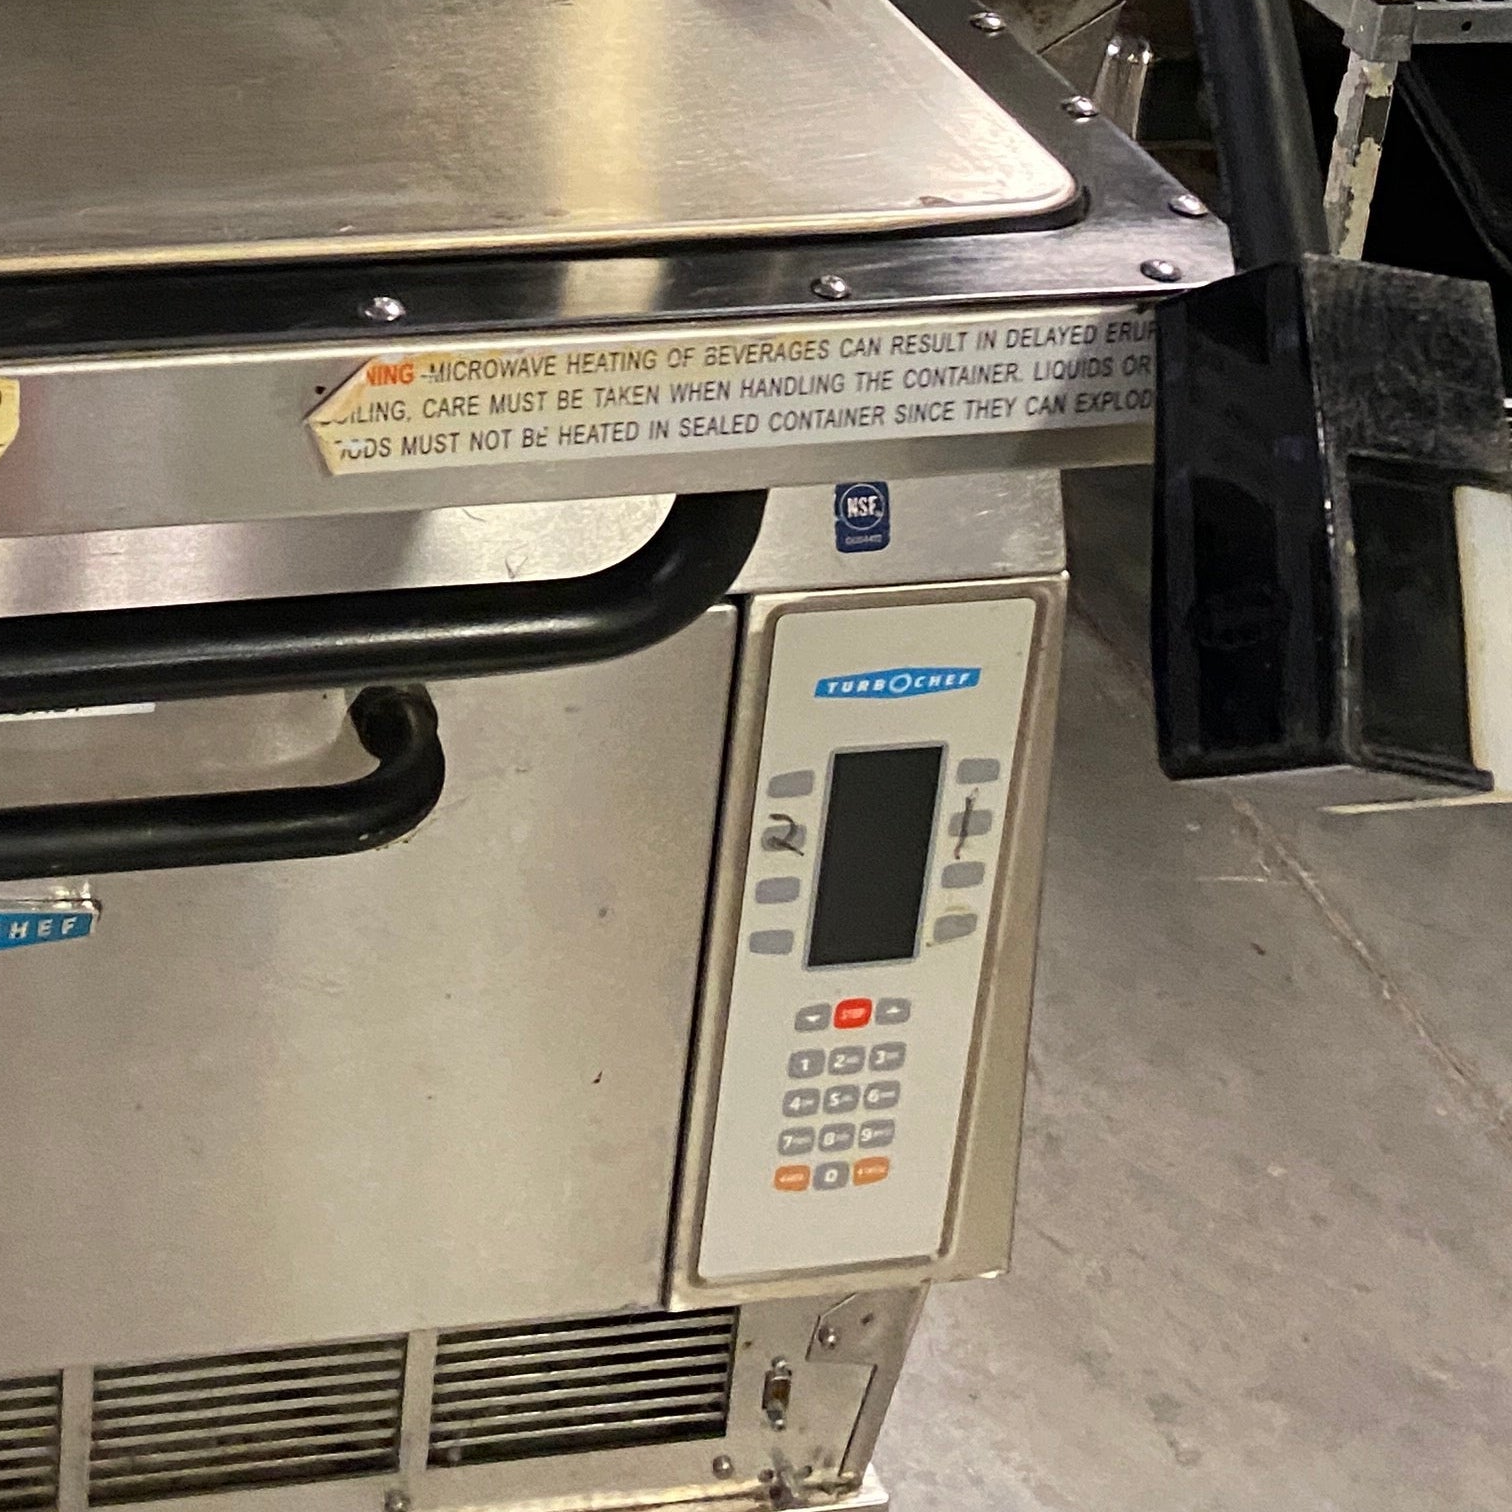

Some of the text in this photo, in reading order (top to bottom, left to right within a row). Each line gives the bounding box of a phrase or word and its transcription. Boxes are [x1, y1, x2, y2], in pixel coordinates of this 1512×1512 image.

[366, 363, 415, 386] NING
[566, 349, 657, 375] HEATING
[667, 347, 696, 368] OF
[704, 339, 831, 367] BEVERAGES
[840, 336, 881, 359] CAN
[890, 331, 968, 355] RESULT
[976, 329, 998, 350] IN
[1005, 324, 1097, 349] DELAYED
[422, 395, 480, 419] CARE
[489, 390, 548, 415] MUST
[556, 388, 584, 411] BE
[595, 385, 660, 408] TAKEN
[670, 380, 731, 404] WHEN
[740, 373, 845, 399] HANDLING
[856, 370, 894, 392] THE
[1033, 356, 1114, 381] LIQUIDS
[1122, 354, 1154, 376] OR
[401, 432, 461, 457] MUST
[470, 428, 512, 452] NOT
[522, 426, 549, 448] BE
[558, 420, 639, 445] HEATED
[648, 419, 670, 440] IN
[678, 413, 759, 438] SEALED
[768, 405, 885, 434] CONTAINER
[894, 400, 955, 425] SINCE
[965, 396, 1018, 421] THEY
[1024, 393, 1066, 417] CAN
[1074, 388, 1153, 414] EXPLOD
[847, 495, 878, 518] NSF
[826, 672, 971, 695] TURBOCHEF
[801, 1058, 810, 1071] 1
